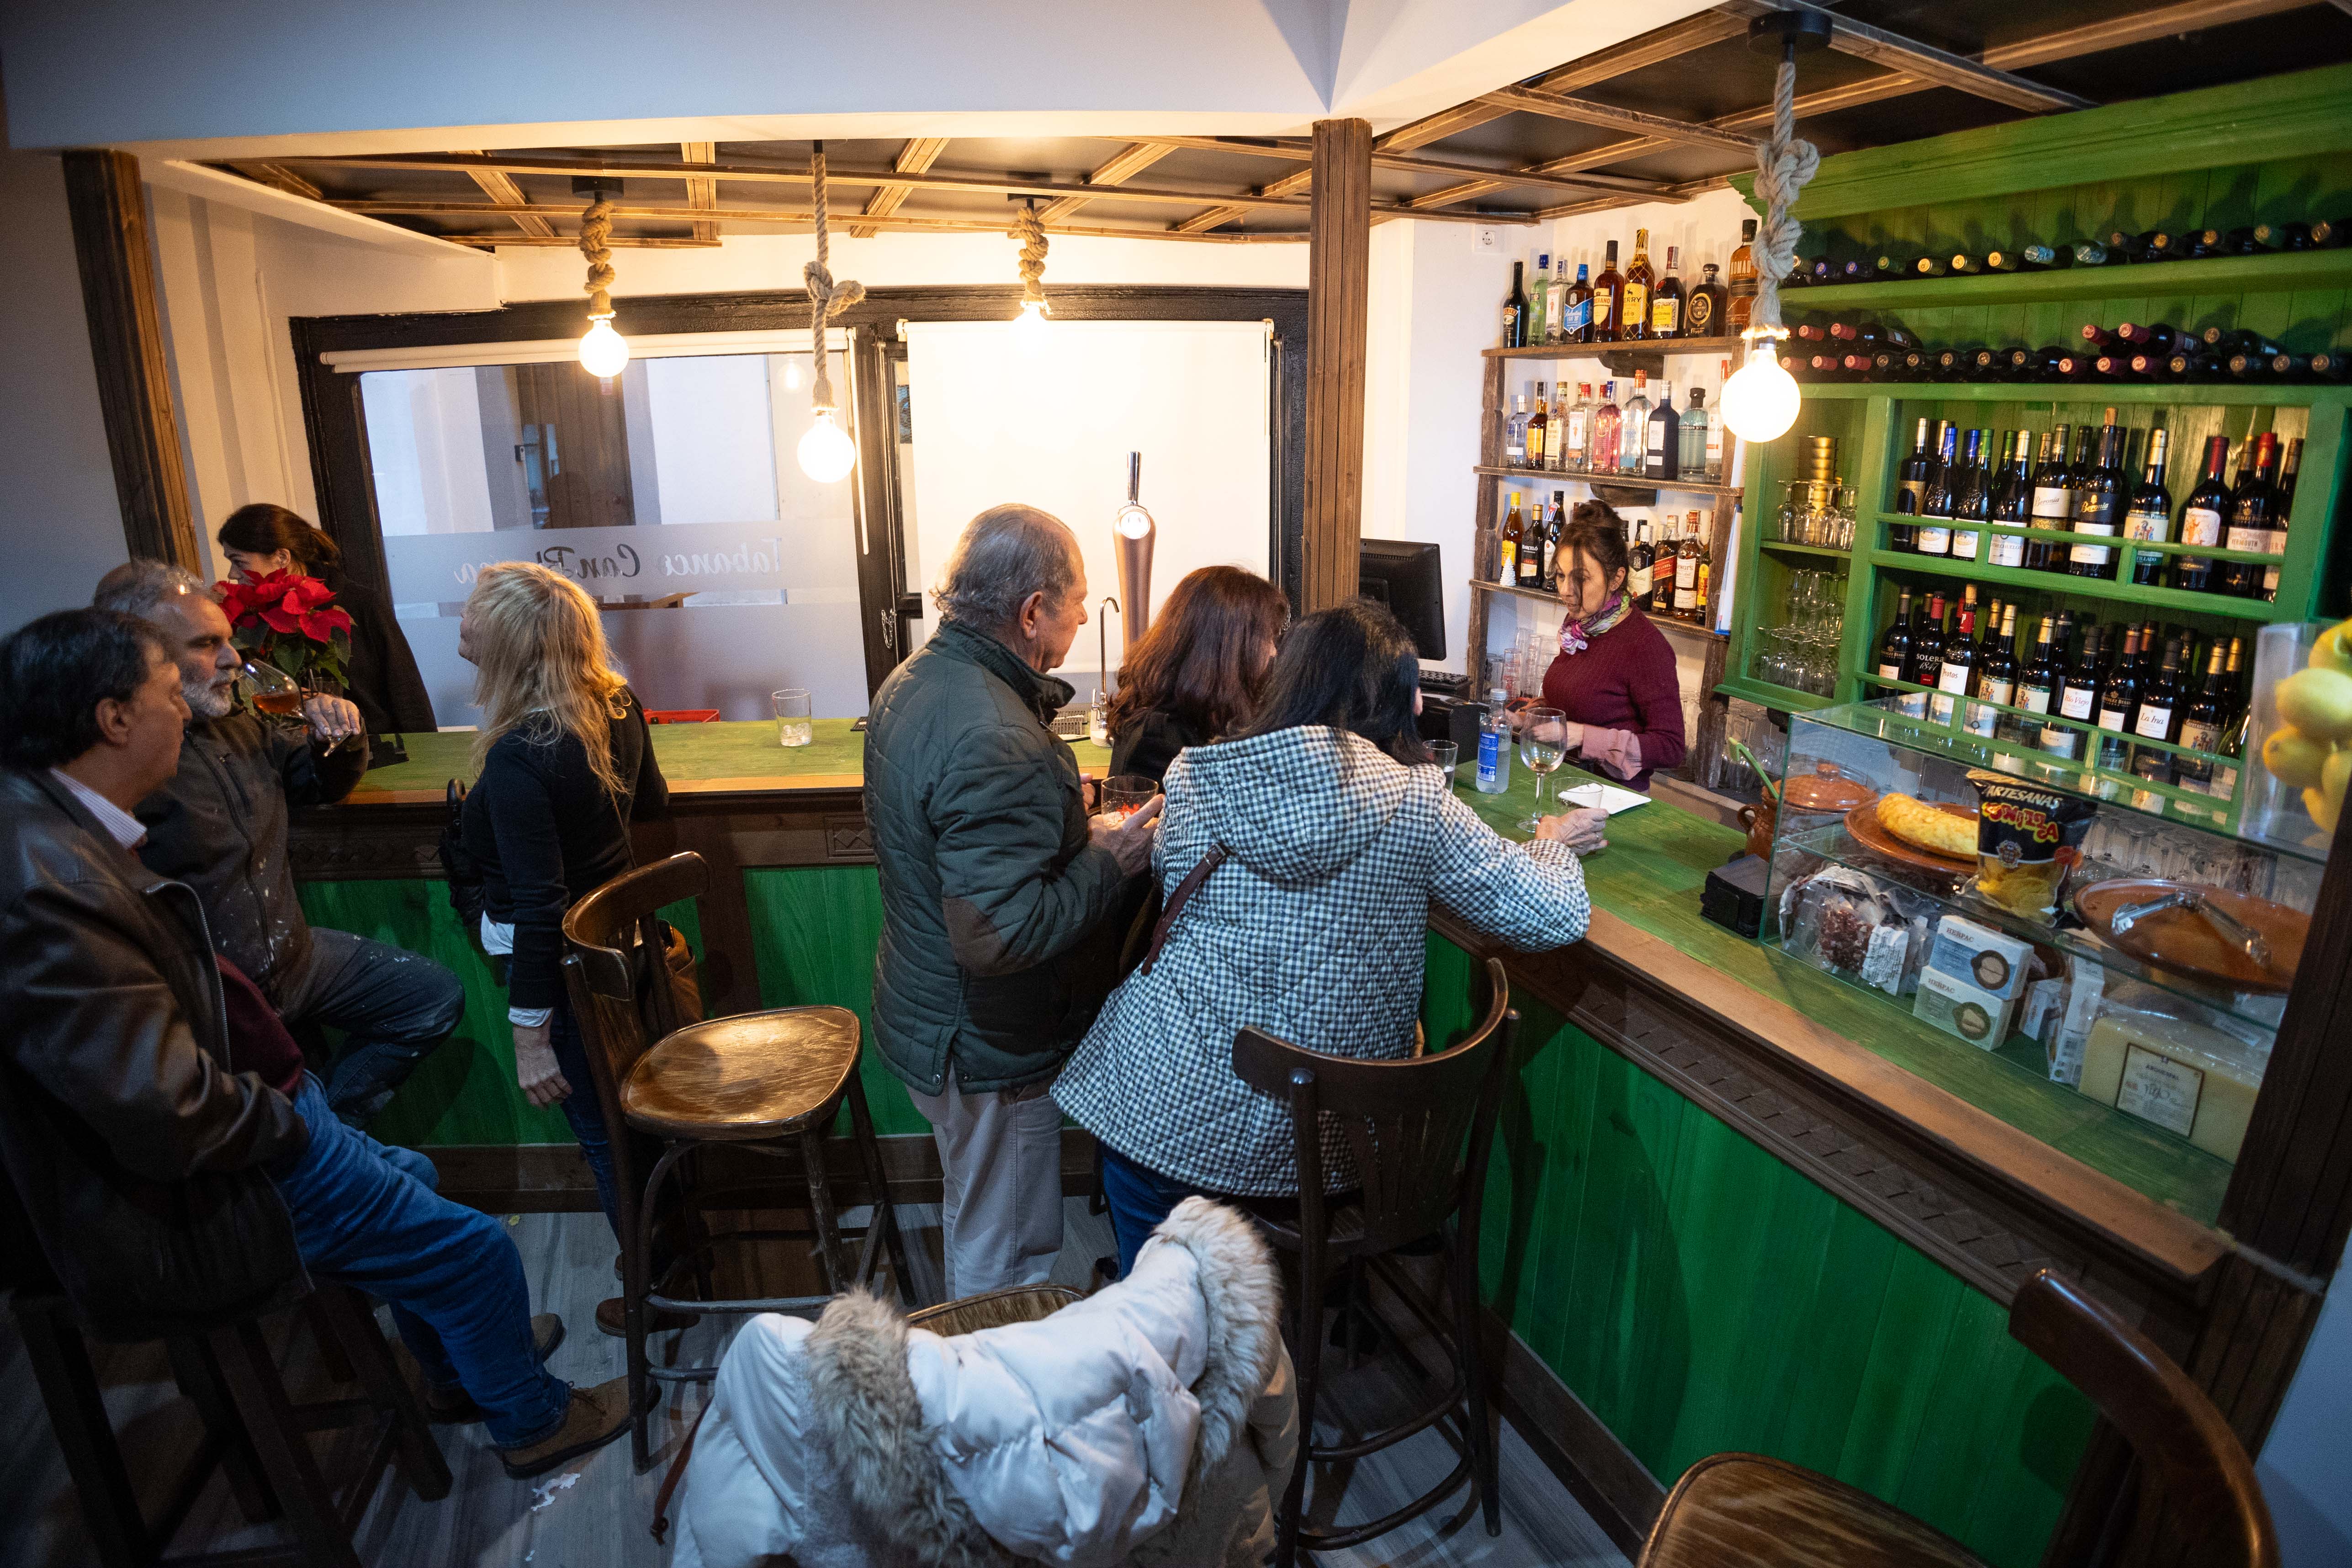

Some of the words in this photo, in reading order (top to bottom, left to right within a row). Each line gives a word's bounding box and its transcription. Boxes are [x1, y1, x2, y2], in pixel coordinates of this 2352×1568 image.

[2034, 496, 2060, 506] Beronia
[2081, 501, 2109, 513] Beronia
[1919, 662, 1939, 671] 1847
[1942, 668, 1958, 679] Protos
[2075, 697, 2089, 706] Viejo
[2141, 713, 2150, 721] La
[2151, 715, 2164, 725] Ina
[1986, 785, 2063, 809] ARTESANAS
[1946, 927, 1974, 943] HERPAC
[1928, 978, 1955, 994] HERPAC
